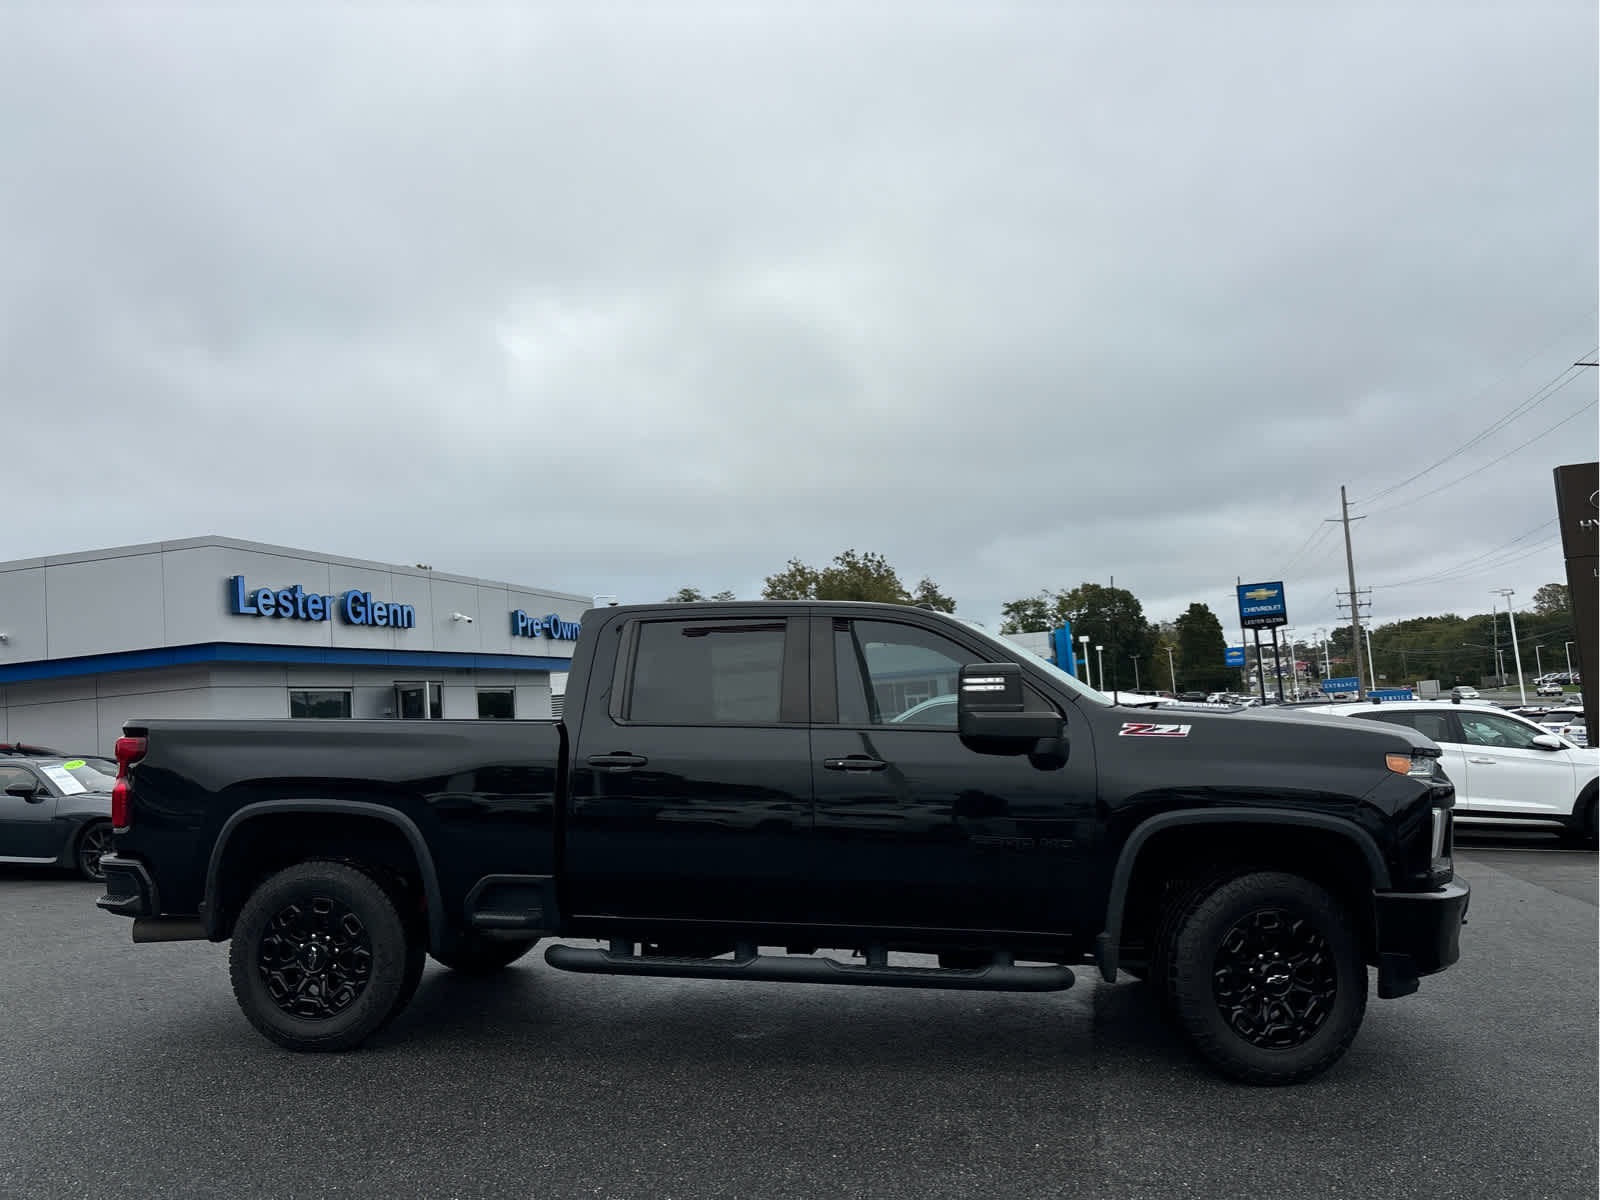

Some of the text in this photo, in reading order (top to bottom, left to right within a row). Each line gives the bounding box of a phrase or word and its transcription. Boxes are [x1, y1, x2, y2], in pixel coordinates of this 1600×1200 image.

[228, 575, 416, 628] Lester Glenn
[512, 609, 581, 640] Pre-Own
[1323, 681, 1358, 690] ENTRANCE
[1118, 722, 1192, 737] Z71
